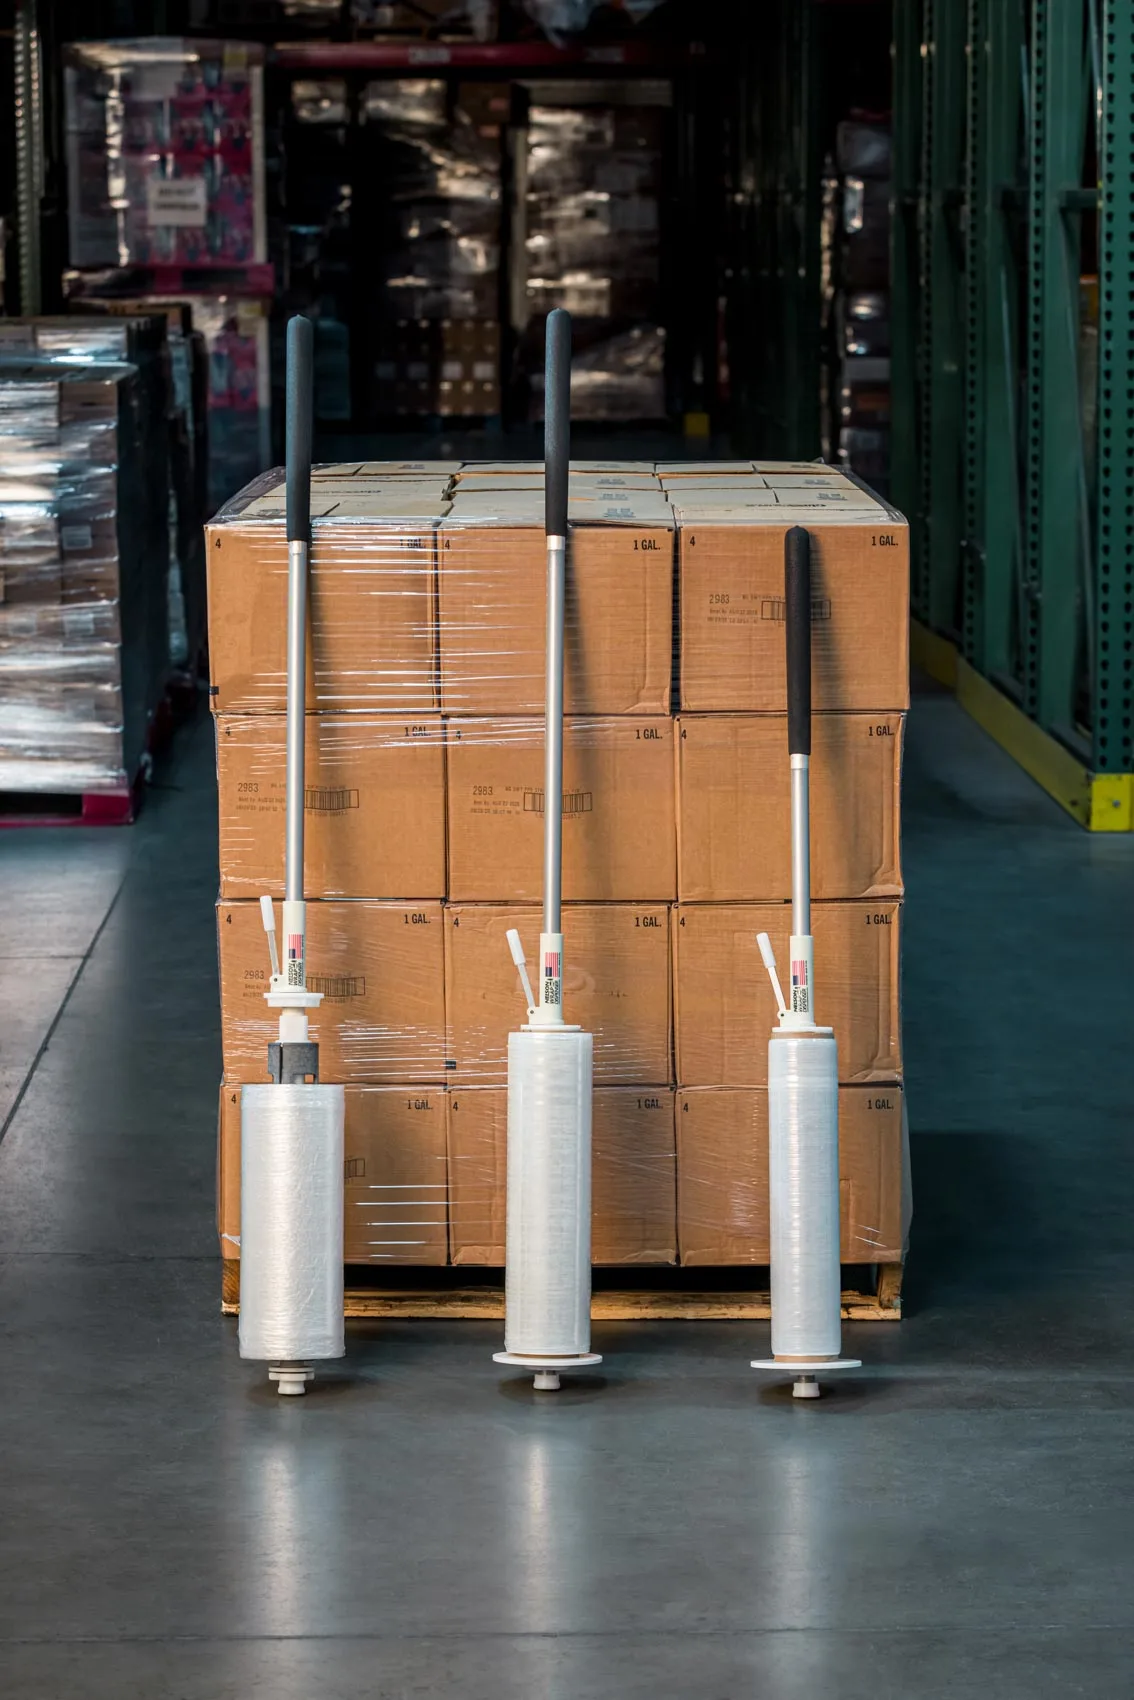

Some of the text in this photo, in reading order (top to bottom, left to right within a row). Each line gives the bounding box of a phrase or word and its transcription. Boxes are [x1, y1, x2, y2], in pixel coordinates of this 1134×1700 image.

[215, 538, 222, 549] 4
[444, 539, 451, 549] 4
[633, 539, 660, 550] 1 GAL.
[690, 536, 696, 546] 4
[871, 536, 898, 546] 1 GAL.
[709, 594, 729, 604] 2983
[636, 729, 663, 739] 1 GAL.
[681, 729, 687, 739] 4
[868, 725, 895, 736] 1 GAL.
[226, 915, 232, 924] 4
[404, 914, 431, 924] 1 GAL.
[453, 918, 459, 927] 4
[635, 917, 662, 927] 1 GAL.
[680, 918, 686, 927] 4
[866, 914, 892, 924] 1 GAL.
[244, 970, 264, 980] 2983
[231, 1094, 237, 1104] 4
[407, 1099, 433, 1110] 1 GAL.
[453, 1102, 459, 1111] 4
[637, 1099, 663, 1110] 1 GAL.
[684, 1102, 689, 1112] 4
[867, 1099, 894, 1110] 1 GAL.
